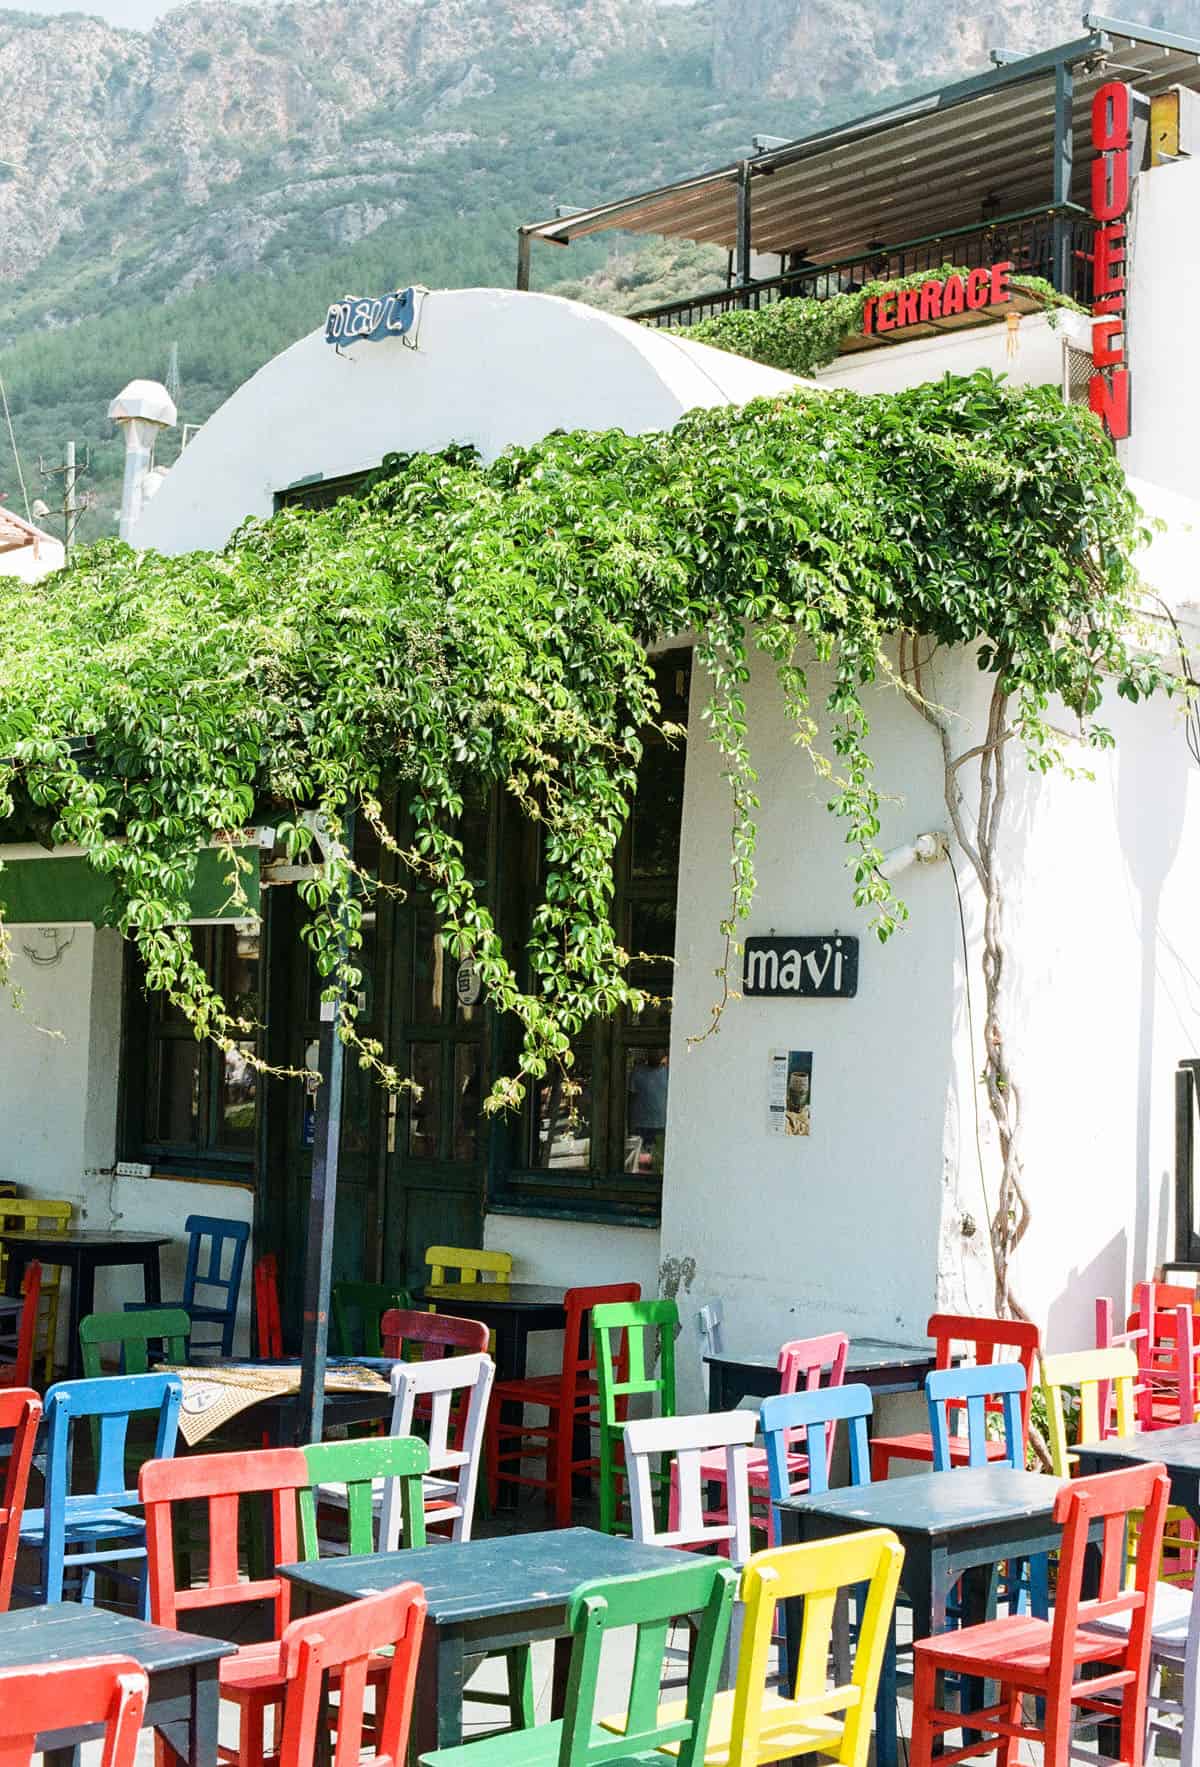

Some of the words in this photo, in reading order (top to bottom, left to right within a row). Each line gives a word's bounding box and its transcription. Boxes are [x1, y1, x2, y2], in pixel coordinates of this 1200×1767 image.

[1089, 81, 1129, 439] QUEEN
[863, 261, 1011, 336] TERRACE
[747, 938, 842, 991] mavi
